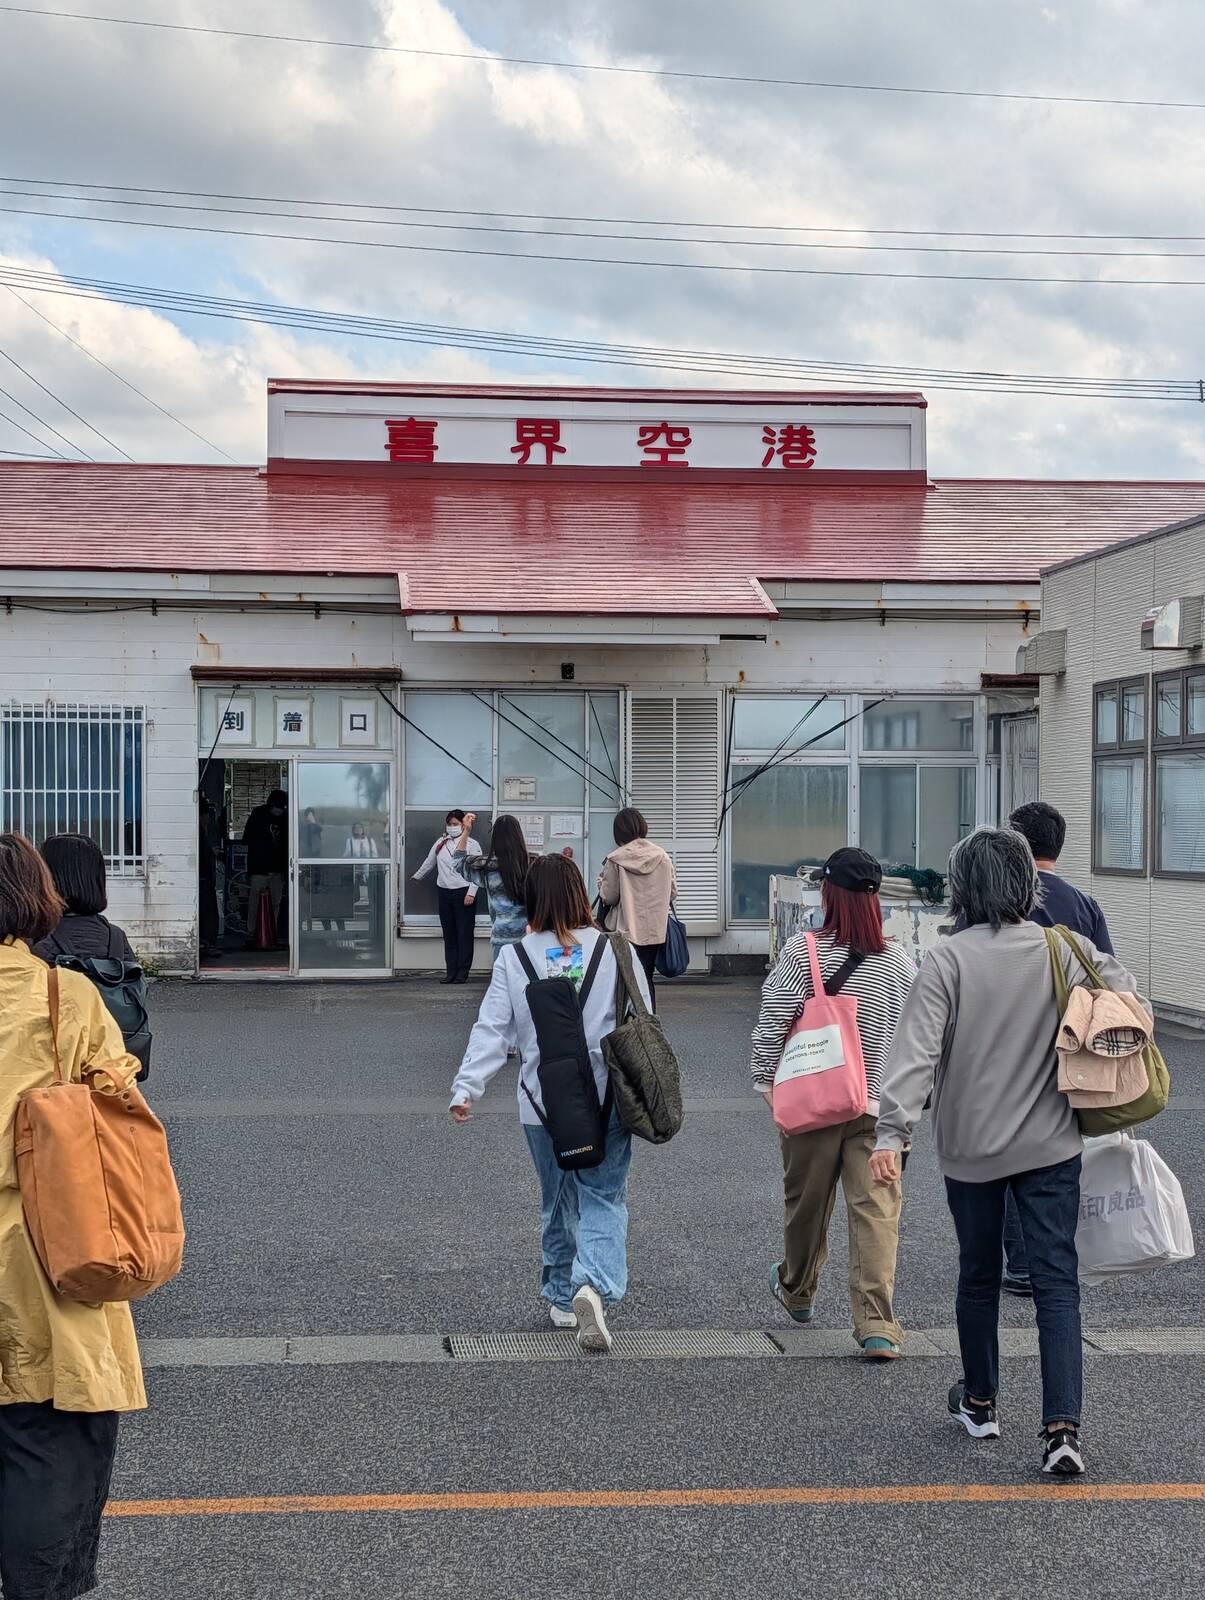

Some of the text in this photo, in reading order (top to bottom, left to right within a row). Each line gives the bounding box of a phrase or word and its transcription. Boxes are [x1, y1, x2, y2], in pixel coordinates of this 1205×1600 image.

[384, 416, 817, 469] 喜界空港
[223, 711, 368, 732] 到着口
